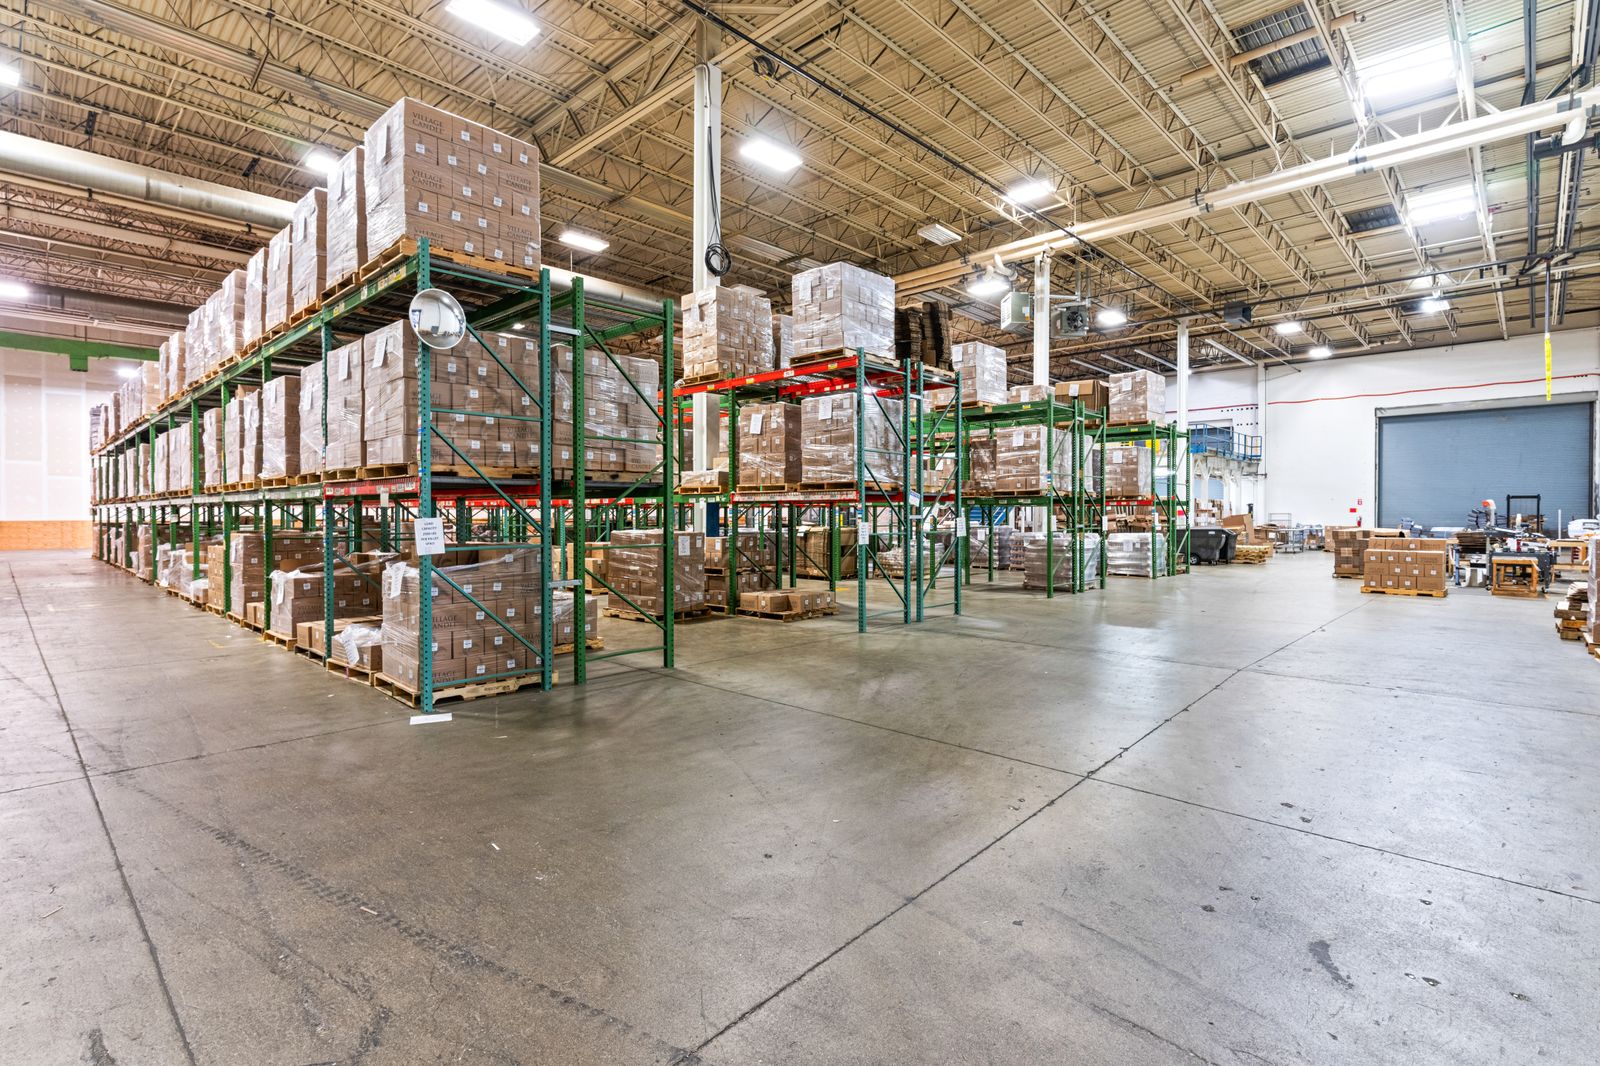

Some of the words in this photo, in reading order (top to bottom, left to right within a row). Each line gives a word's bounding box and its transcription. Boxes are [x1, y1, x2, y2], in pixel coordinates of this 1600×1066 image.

[412, 111, 442, 128] VILLAGE
[412, 118, 444, 135] CANDLE
[411, 175, 445, 190] CANDLE
[412, 168, 442, 183] VILLAGE
